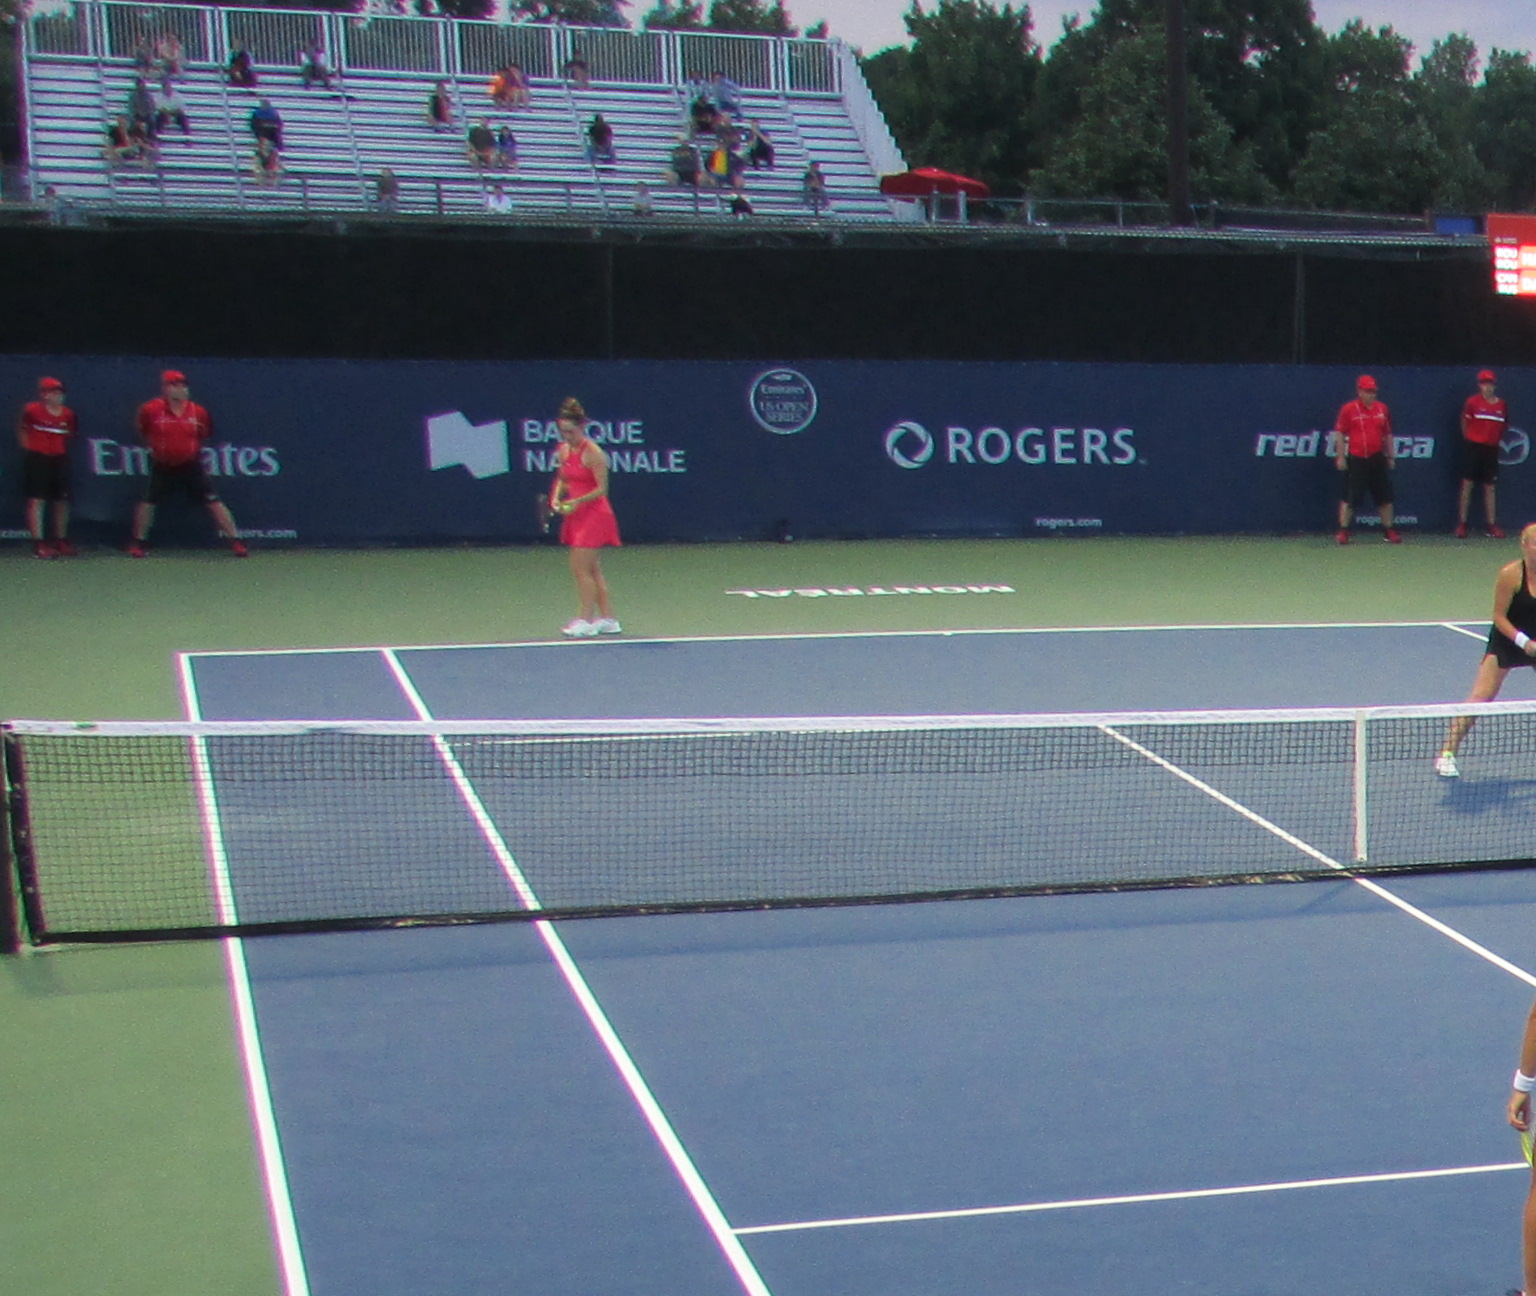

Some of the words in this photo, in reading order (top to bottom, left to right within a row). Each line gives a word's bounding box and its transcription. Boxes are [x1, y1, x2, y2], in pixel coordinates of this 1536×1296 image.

[523, 420, 645, 444] BAQUE
[90, 438, 282, 476] Emates
[946, 427, 1138, 465] ROGERS
[1036, 518, 1102, 529] rogers.com
[1356, 515, 1419, 527] roge.com
